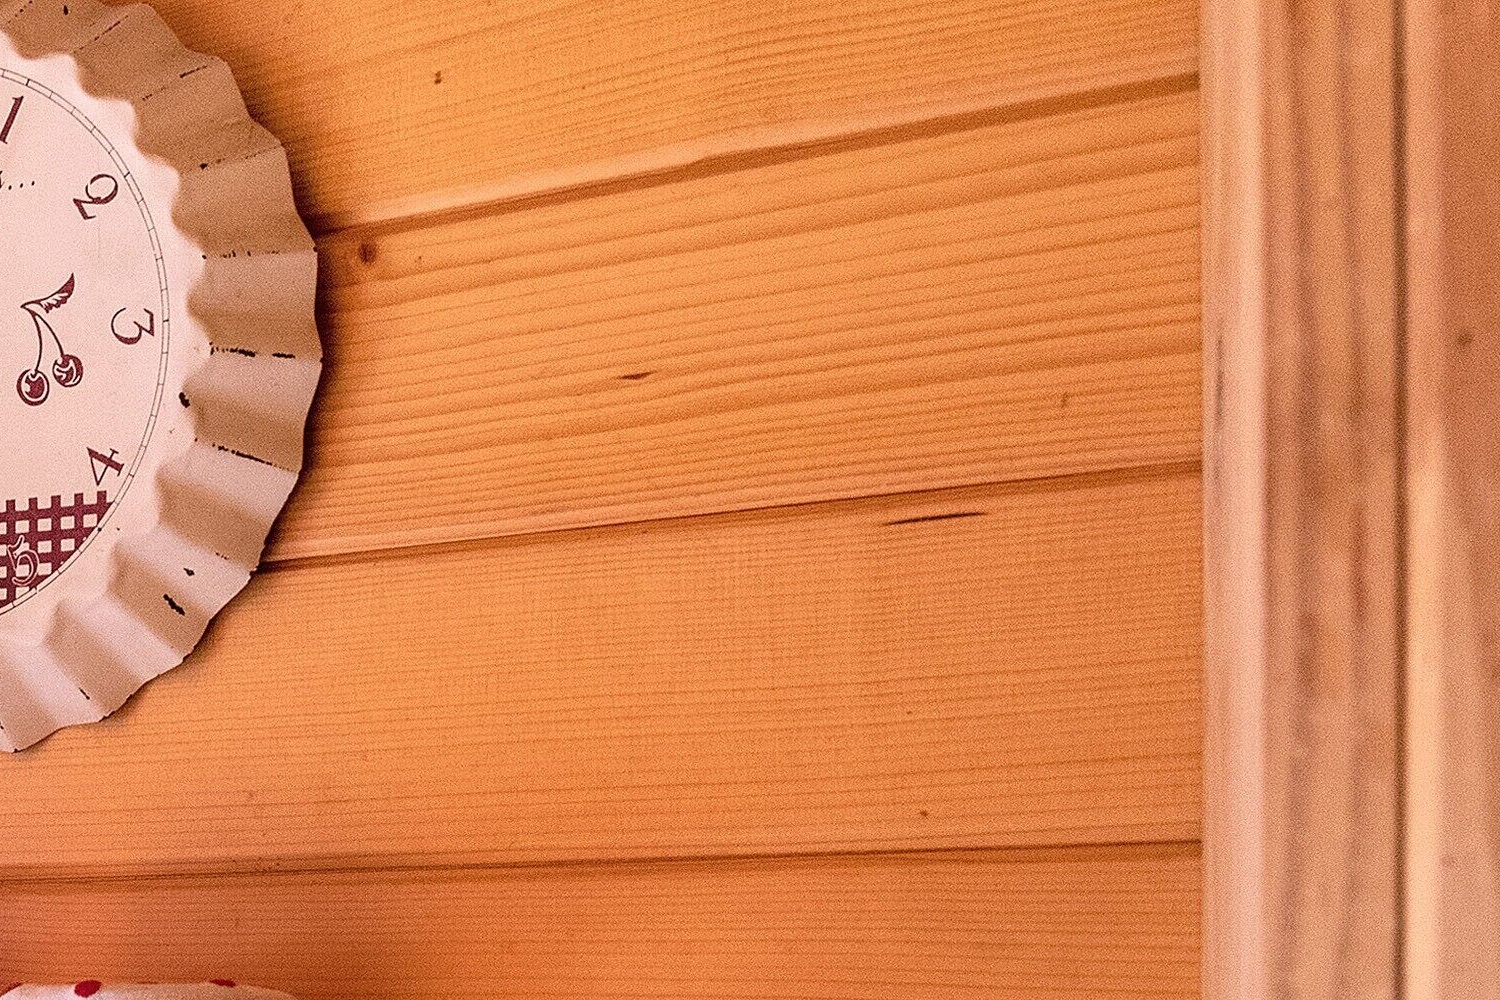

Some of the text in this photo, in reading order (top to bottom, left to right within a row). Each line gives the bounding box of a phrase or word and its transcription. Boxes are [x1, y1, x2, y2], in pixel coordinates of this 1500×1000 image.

[73, 173, 119, 221] 2
[111, 306, 155, 345] 3
[86, 446, 126, 486] 4
[8, 535, 40, 587] 5
